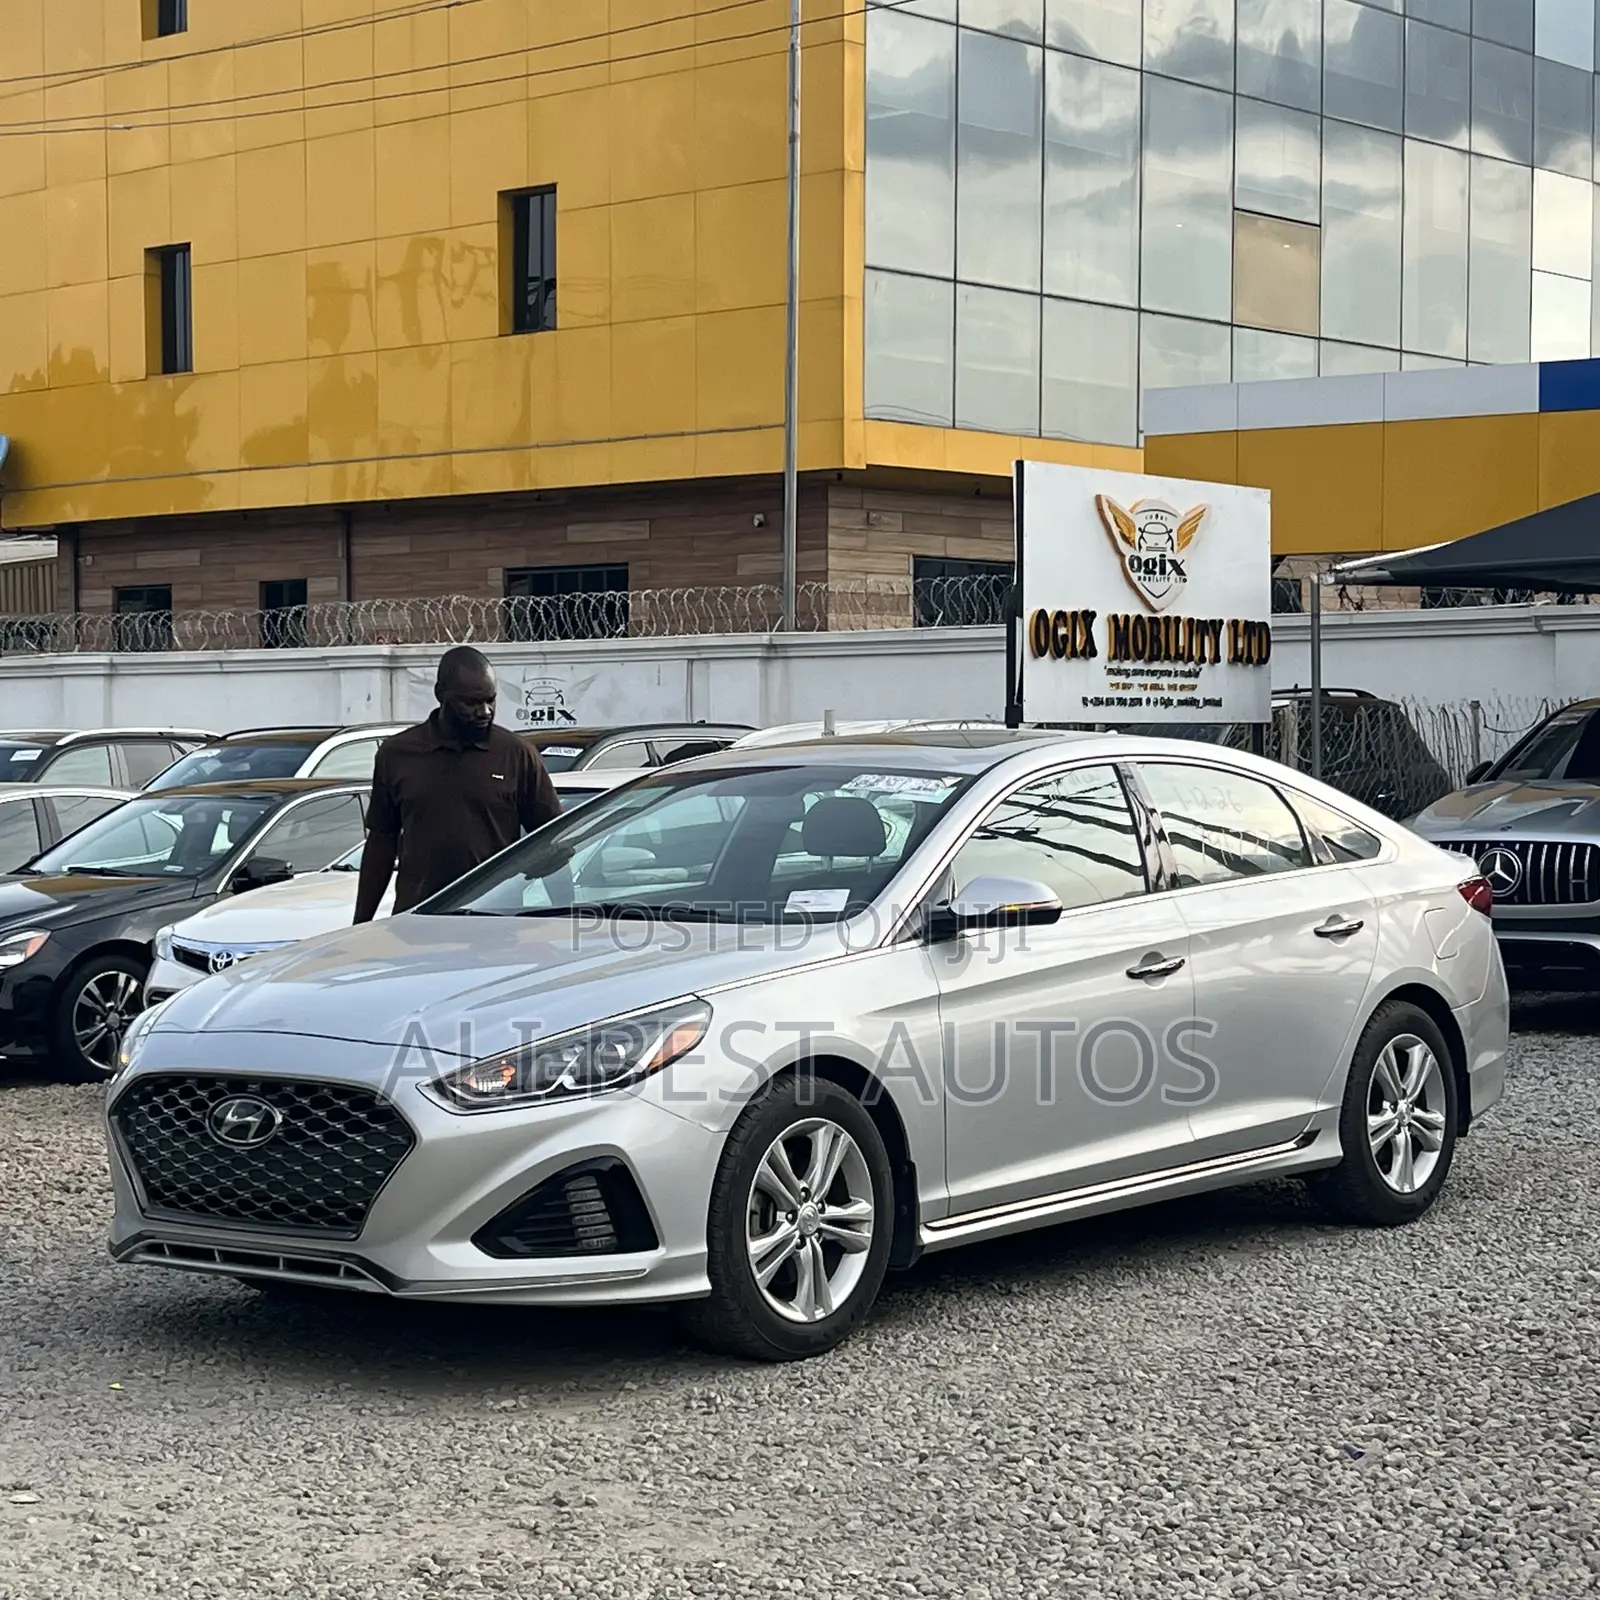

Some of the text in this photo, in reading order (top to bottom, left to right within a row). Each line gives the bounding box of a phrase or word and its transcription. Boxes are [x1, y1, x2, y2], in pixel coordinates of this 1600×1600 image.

[1030, 608, 1271, 666] OGIX MOBILITY LTD
